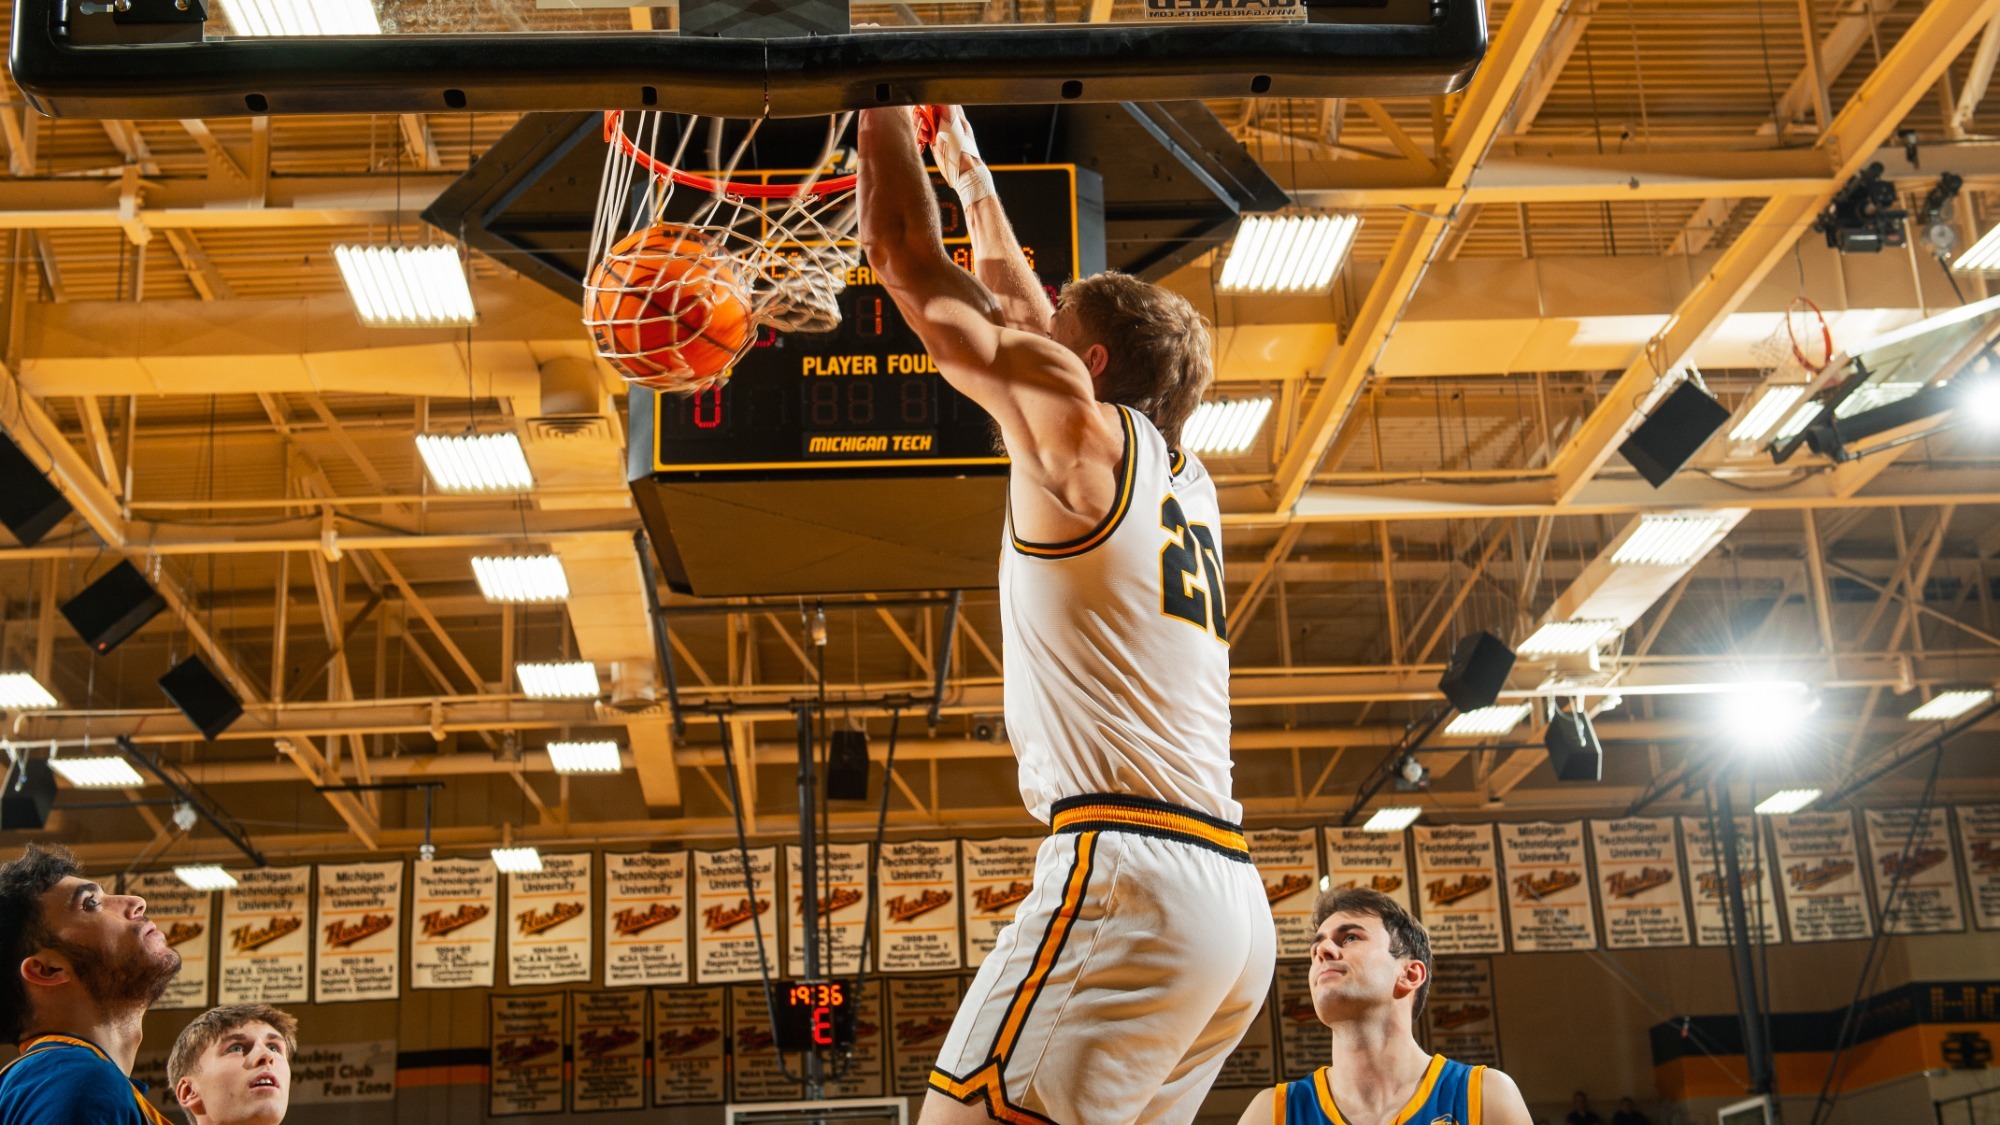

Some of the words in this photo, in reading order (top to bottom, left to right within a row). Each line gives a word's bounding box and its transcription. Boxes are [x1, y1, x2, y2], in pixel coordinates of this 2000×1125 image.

[802, 355, 877, 375] PLAYER
[808, 436, 888, 452] MICHIGAN
[892, 435, 932, 450] TECH
[1518, 826, 1566, 838] Michigan
[1609, 822, 1657, 833] Michigan
[1253, 833, 1301, 843] Michigan
[1431, 829, 1477, 841] Michigan
[1598, 833, 1671, 848] Technological
[980, 845, 1028, 856] Michigan
[1331, 841, 1402, 855] Technological
[1418, 841, 1490, 855] Technological
[1507, 837, 1580, 851] Technological
[892, 845, 940, 857] Michigan
[1518, 851, 1571, 863] University
[1610, 847, 1662, 859] University
[622, 856, 671, 868] Michigan
[882, 856, 954, 868] Technological
[1341, 855, 1393, 867] University
[1430, 855, 1482, 867] University
[336, 871, 385, 882] Michigan
[432, 865, 480, 875] Michigan
[515, 868, 587, 882] Technological
[611, 868, 685, 882] Technological
[890, 870, 943, 881] University
[978, 866, 1031, 878] University
[241, 872, 292, 884] Michigan
[420, 876, 493, 887] Technological
[1605, 866, 1673, 900] Huskies
[230, 884, 305, 899] Technological
[324, 883, 397, 897] Technological
[429, 886, 482, 898] University
[522, 880, 575, 893] University
[619, 882, 672, 895] University
[1426, 874, 1493, 907] Huskies
[1512, 869, 1582, 902] Huskies
[238, 899, 293, 911] University
[332, 897, 386, 909] University
[885, 889, 954, 925] Huskies
[420, 904, 490, 938] Huskies
[516, 902, 586, 937] Huskies
[613, 903, 681, 937] Huskies
[230, 916, 302, 952] Huskies
[324, 914, 394, 950] Huskies
[790, 984, 844, 1007] 19:36
[339, 1064, 374, 1079] Club
[323, 1082, 352, 1096] Fan
[357, 1081, 392, 1095] Zone
